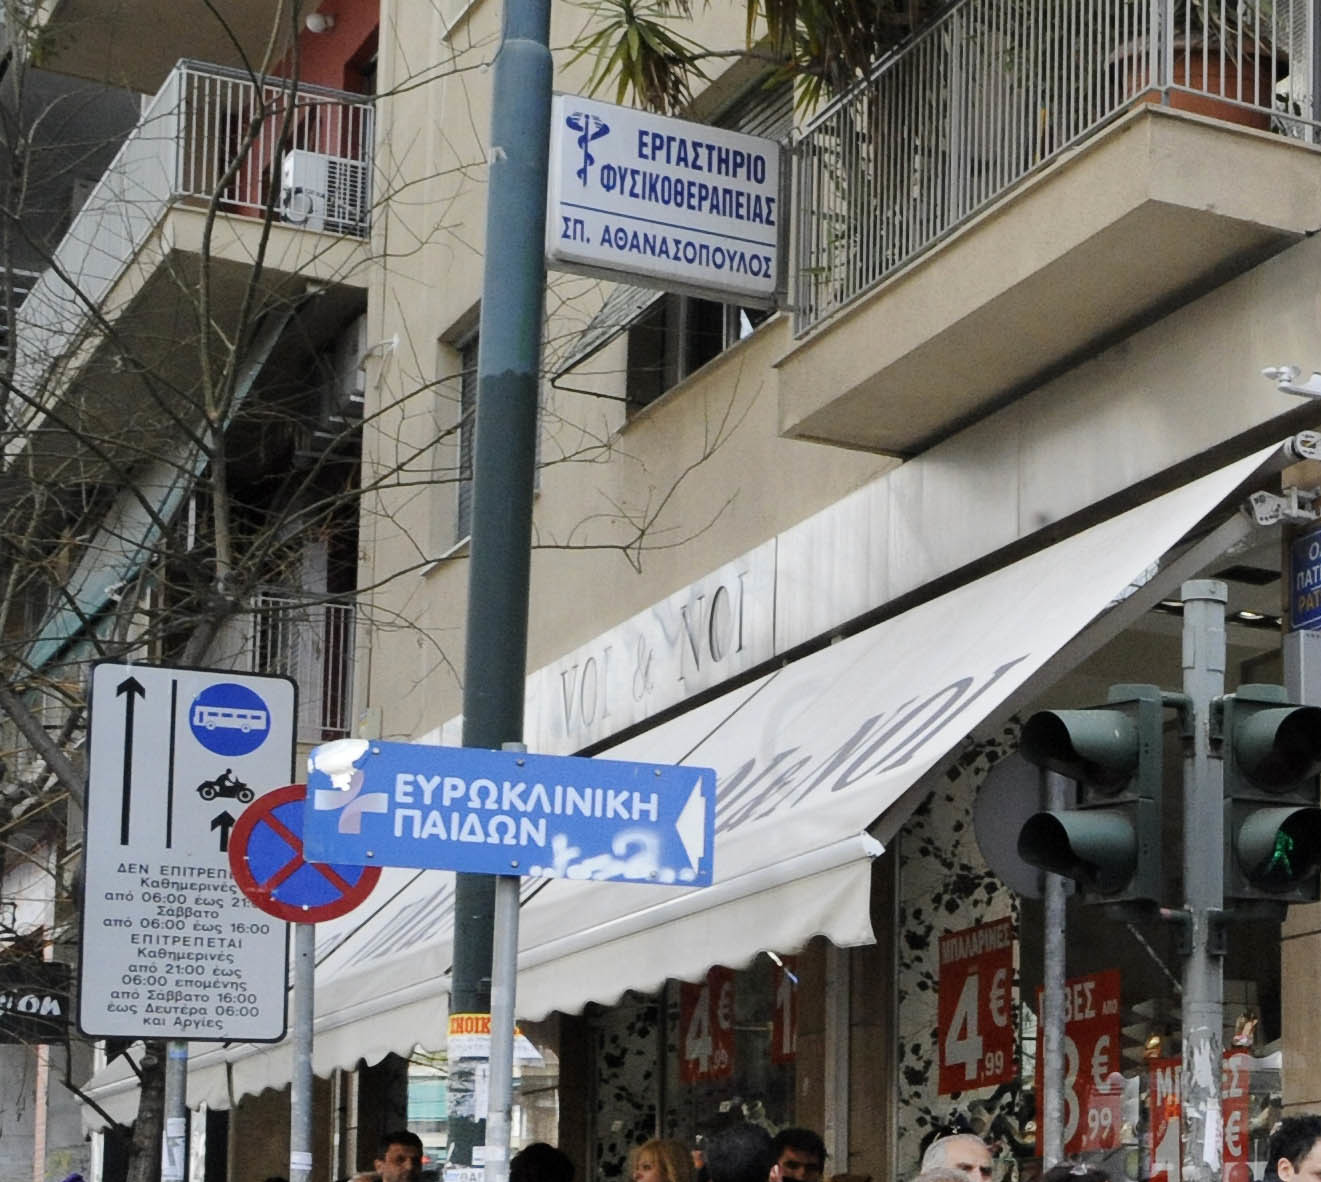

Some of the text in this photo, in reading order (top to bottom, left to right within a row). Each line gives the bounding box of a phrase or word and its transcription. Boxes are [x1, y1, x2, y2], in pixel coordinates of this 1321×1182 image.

[637, 128, 767, 185] ΕΡΓΑΣΤΗΡΙΟ
[600, 163, 776, 226] ΦΥΣΙΚΟΘΕΡΑΠΕΙΑΣ
[561, 216, 773, 279] ΣΠ. ΑΘΑΝΑΣΟΠΟΥΛΟΣ
[560, 646, 612, 737] VOI
[677, 570, 748, 673] NOI
[394, 772, 659, 822] ΕΥΡΩΚΛΙΝΙΚΗ
[394, 808, 547, 848] ΠΑΙΔΩΝ
[117, 863, 234, 879] ΔΕΝ ΕΠΙΤΡΕΠ
[140, 878, 237, 894] Καθημερινές
[104, 891, 134, 902] από
[141, 892, 187, 905] 06:00
[157, 905, 220, 919] Σάββατο
[103, 917, 270, 935] από 06:00 έως 16:00
[131, 934, 243, 949] ΕΠΙΤΡΕΠΕΤΑΙ
[137, 948, 234, 964] Καθημερινές
[128, 963, 242, 979] από 21:00 έως
[122, 975, 247, 992] 06:00 επομένης
[110, 990, 257, 1005] από Σάββατο 16:00
[107, 1003, 260, 1017] έως Δευτέρα 06:00
[143, 1016, 223, 1030] και Αργίες
